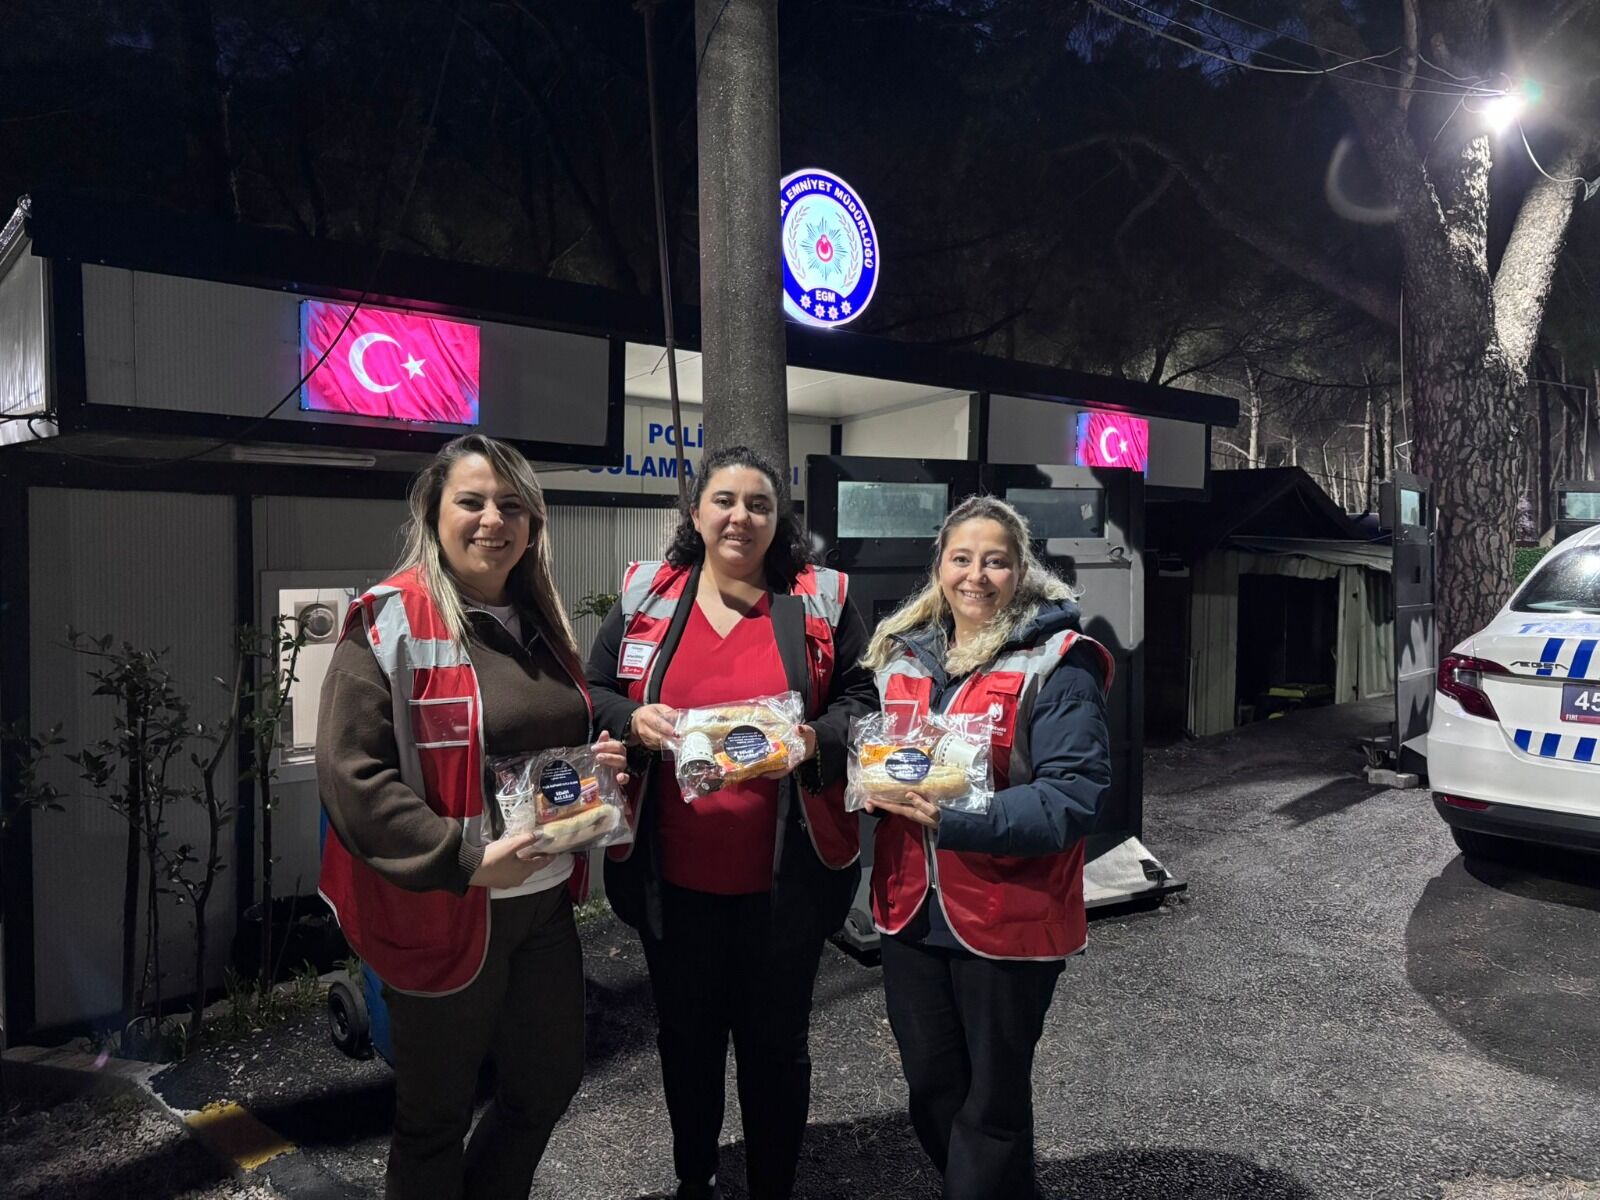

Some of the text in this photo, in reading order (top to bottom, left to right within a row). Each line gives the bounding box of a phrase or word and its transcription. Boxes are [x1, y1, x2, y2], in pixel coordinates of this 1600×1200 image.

[786, 177, 833, 202] EMNİYET
[834, 186, 874, 270] MÜDÜRLÜĞÜ
[815, 288, 836, 303] EGM
[649, 423, 703, 448] POLİ
[1518, 622, 1600, 634] TRA
[1574, 690, 1600, 713] 45
